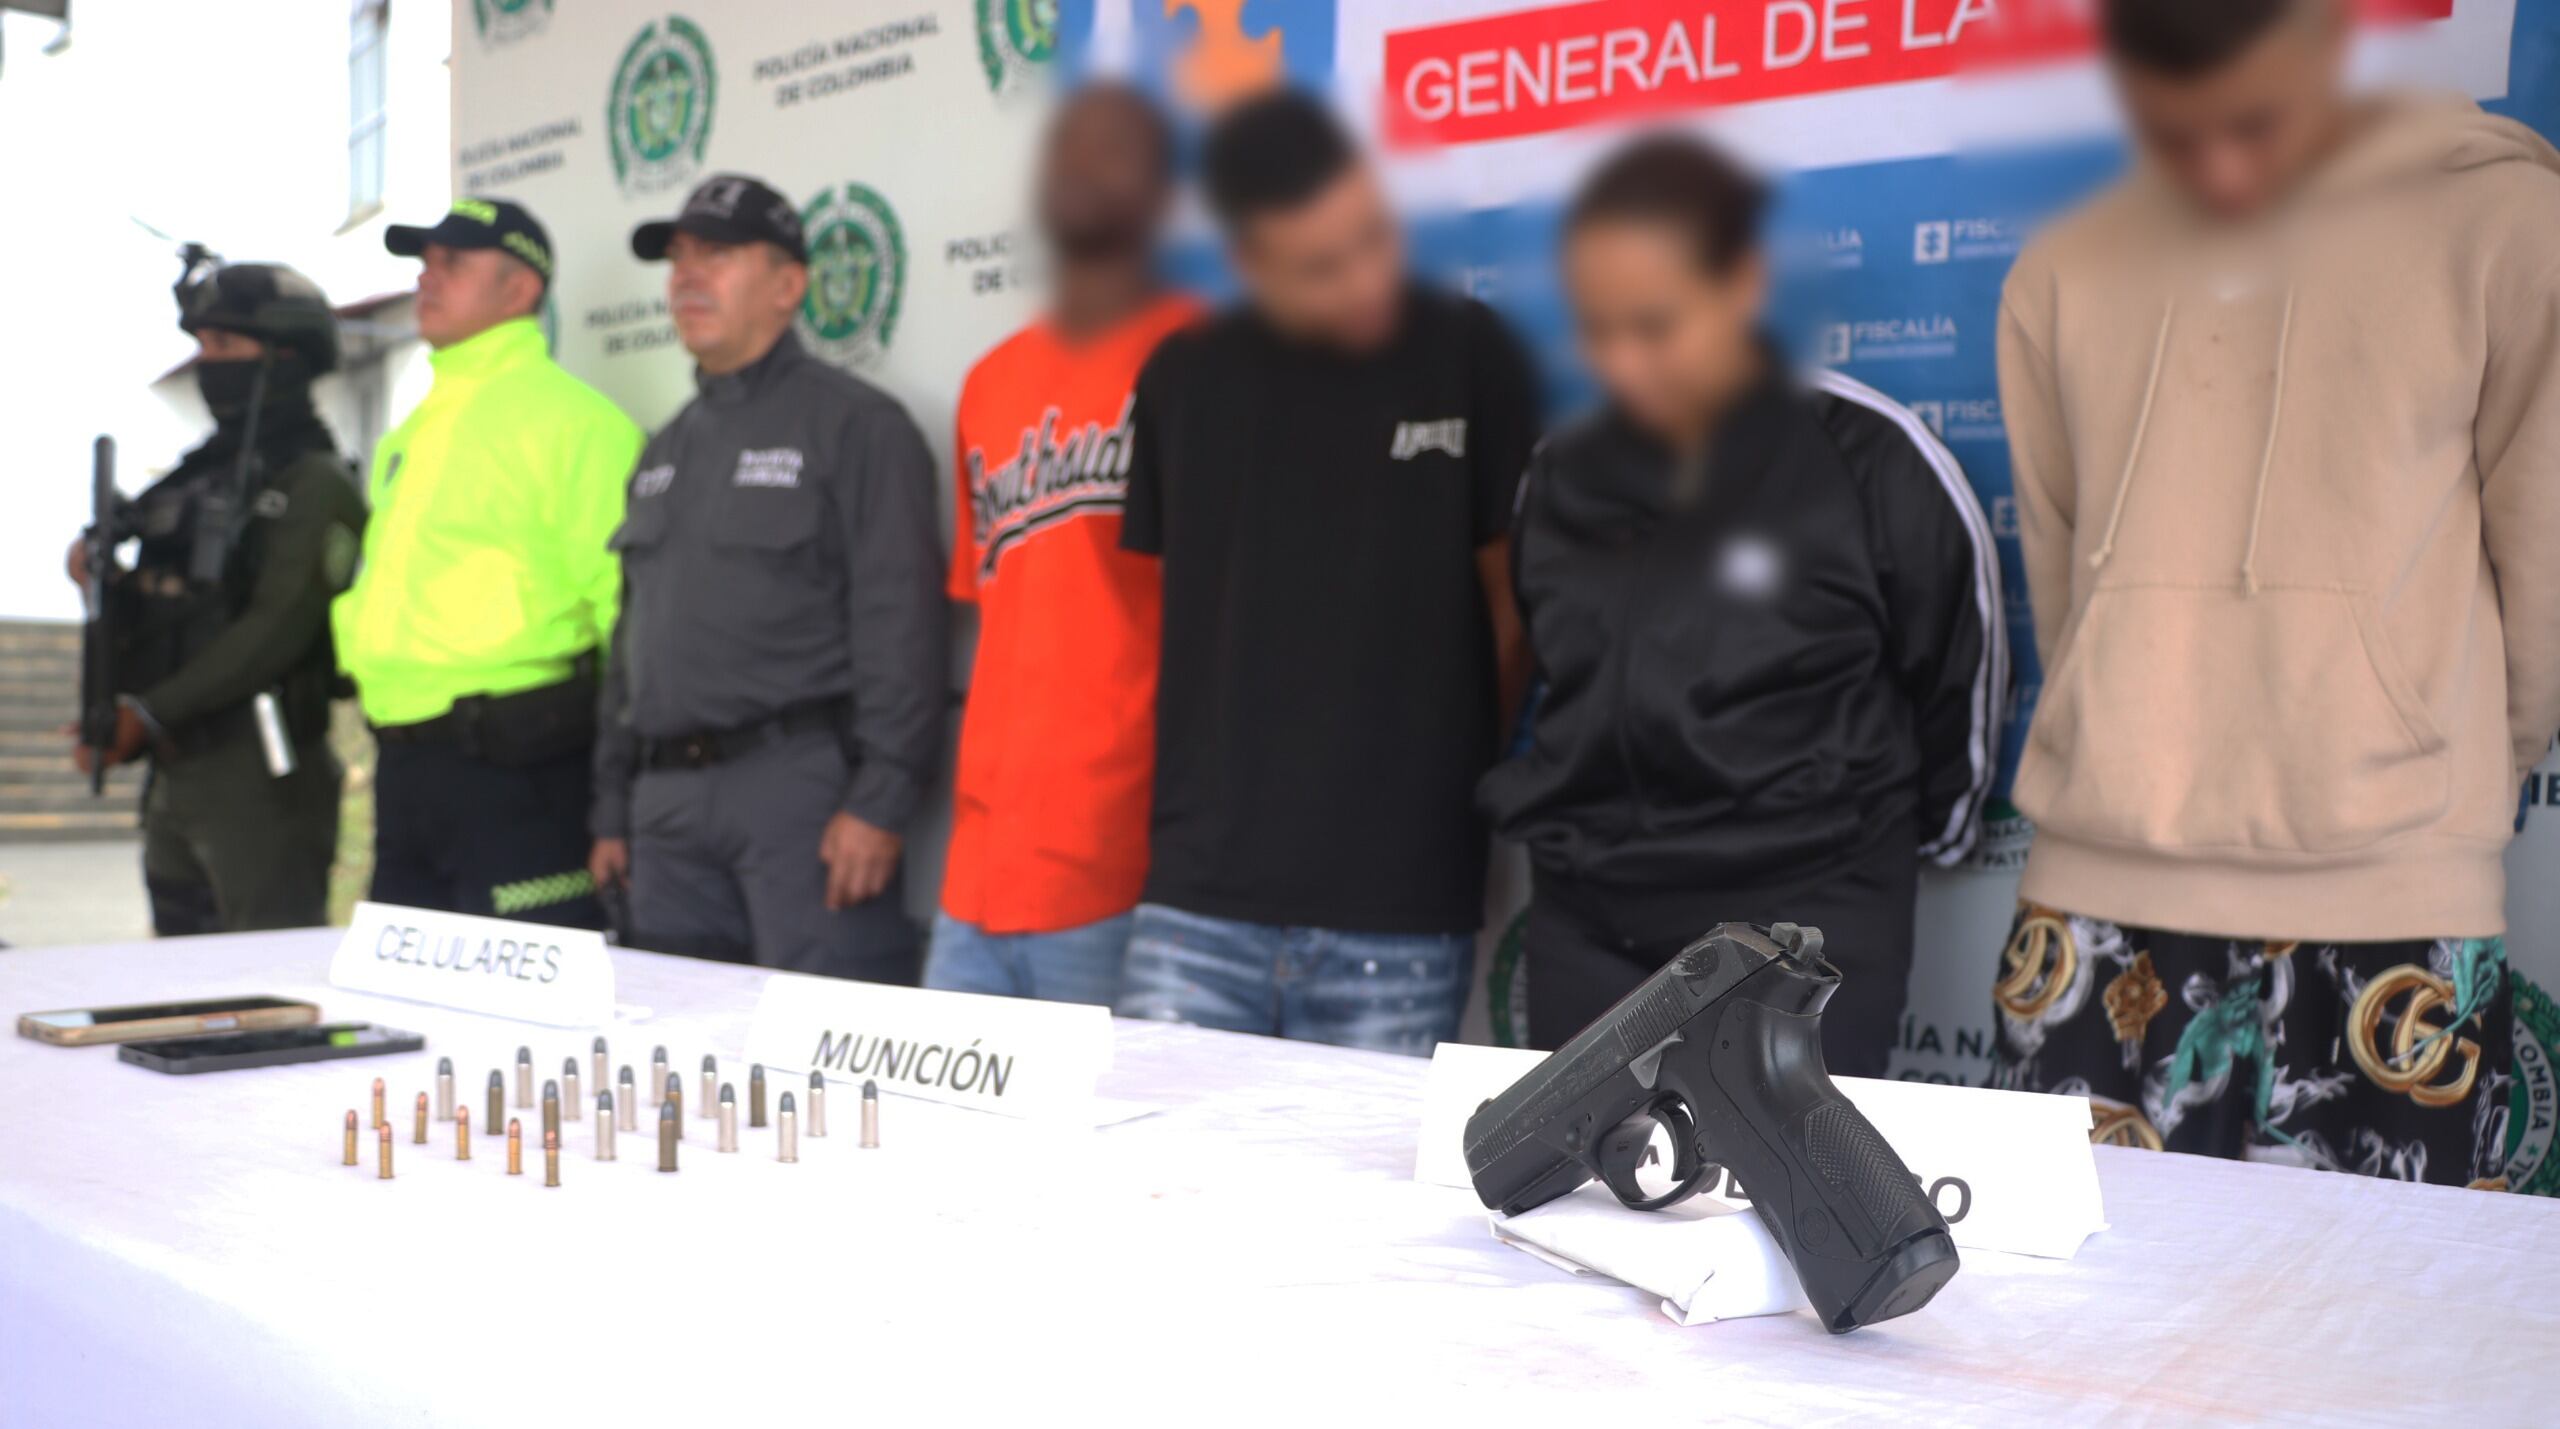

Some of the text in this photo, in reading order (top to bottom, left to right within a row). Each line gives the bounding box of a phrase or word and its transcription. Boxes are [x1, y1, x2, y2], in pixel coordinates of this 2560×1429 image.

[832, 13, 941, 58] NACIONAL
[775, 53, 915, 107] DE COLOMBIA
[1403, 0, 1999, 121] GENERAL DE LA
[507, 116, 583, 151] NACIONAL
[490, 150, 565, 183] COLOMBIA
[945, 232, 1009, 264] POLIC
[972, 266, 1002, 297] DE
[605, 321, 678, 356] DE COLO
[1854, 313, 1957, 341] FISCALÍA
[969, 390, 1138, 543] Southsid
[375, 924, 562, 984] CELULARES
[810, 1029, 1014, 1097] MUNICIÓN
